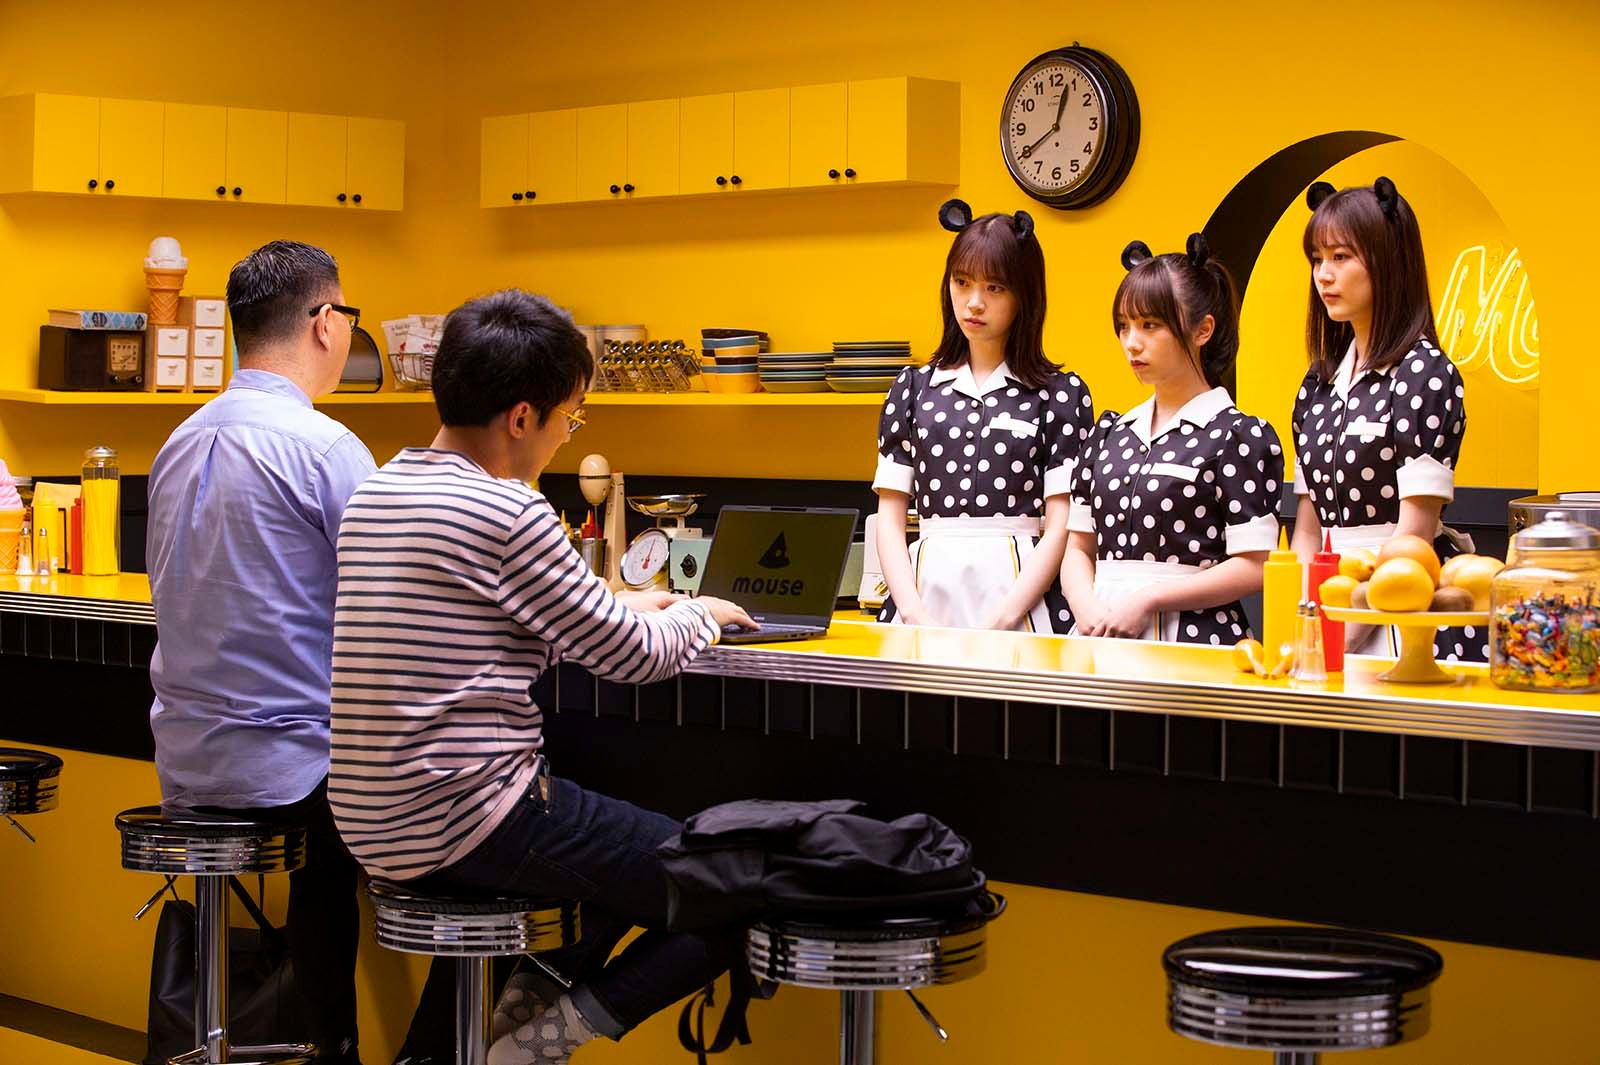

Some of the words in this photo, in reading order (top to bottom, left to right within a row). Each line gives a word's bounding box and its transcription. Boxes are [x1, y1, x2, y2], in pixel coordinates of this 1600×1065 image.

[1049, 73, 1064, 87] 12
[1071, 78, 1076, 91] 1
[1033, 82, 1044, 95] 11
[1021, 99, 1035, 112] 10
[1083, 93, 1092, 106] 2
[1016, 123, 1026, 136] 9
[1089, 117, 1098, 130] 3
[1083, 142, 1092, 155] 4
[1034, 161, 1043, 174] 7
[1070, 159, 1080, 172] 5
[1052, 167, 1061, 180] 6
[732, 577, 803, 595] mouse
